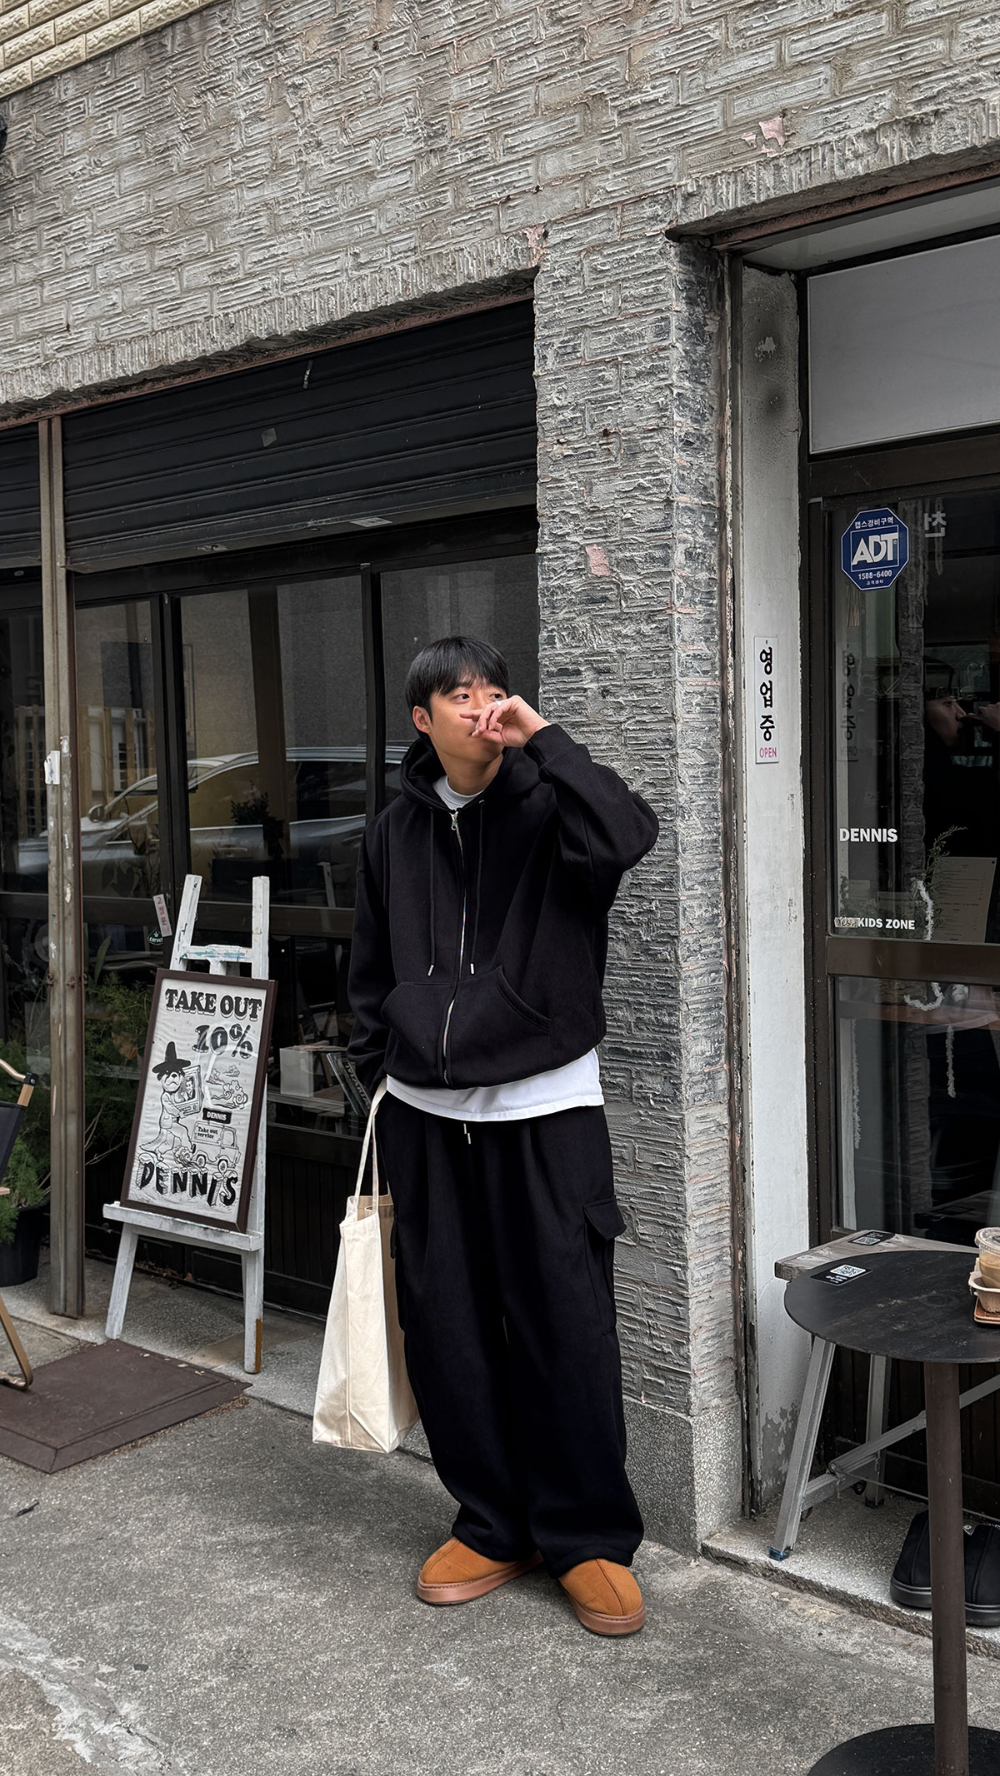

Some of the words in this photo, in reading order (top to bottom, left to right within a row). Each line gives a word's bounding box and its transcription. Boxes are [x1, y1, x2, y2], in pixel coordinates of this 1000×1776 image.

[851, 532, 898, 566] ADT
[858, 569, 893, 580] 1588-6400
[759, 646, 775, 742] 영업중
[759, 747, 777, 758] OPEN
[839, 828, 898, 843] DENNIS
[858, 917, 883, 928] KIDS
[885, 918, 916, 930] ZONE
[165, 988, 217, 1017] TAKE
[220, 995, 262, 1022] OUT
[192, 1023, 254, 1060] 10%
[136, 1153, 238, 1207] DENNIS
